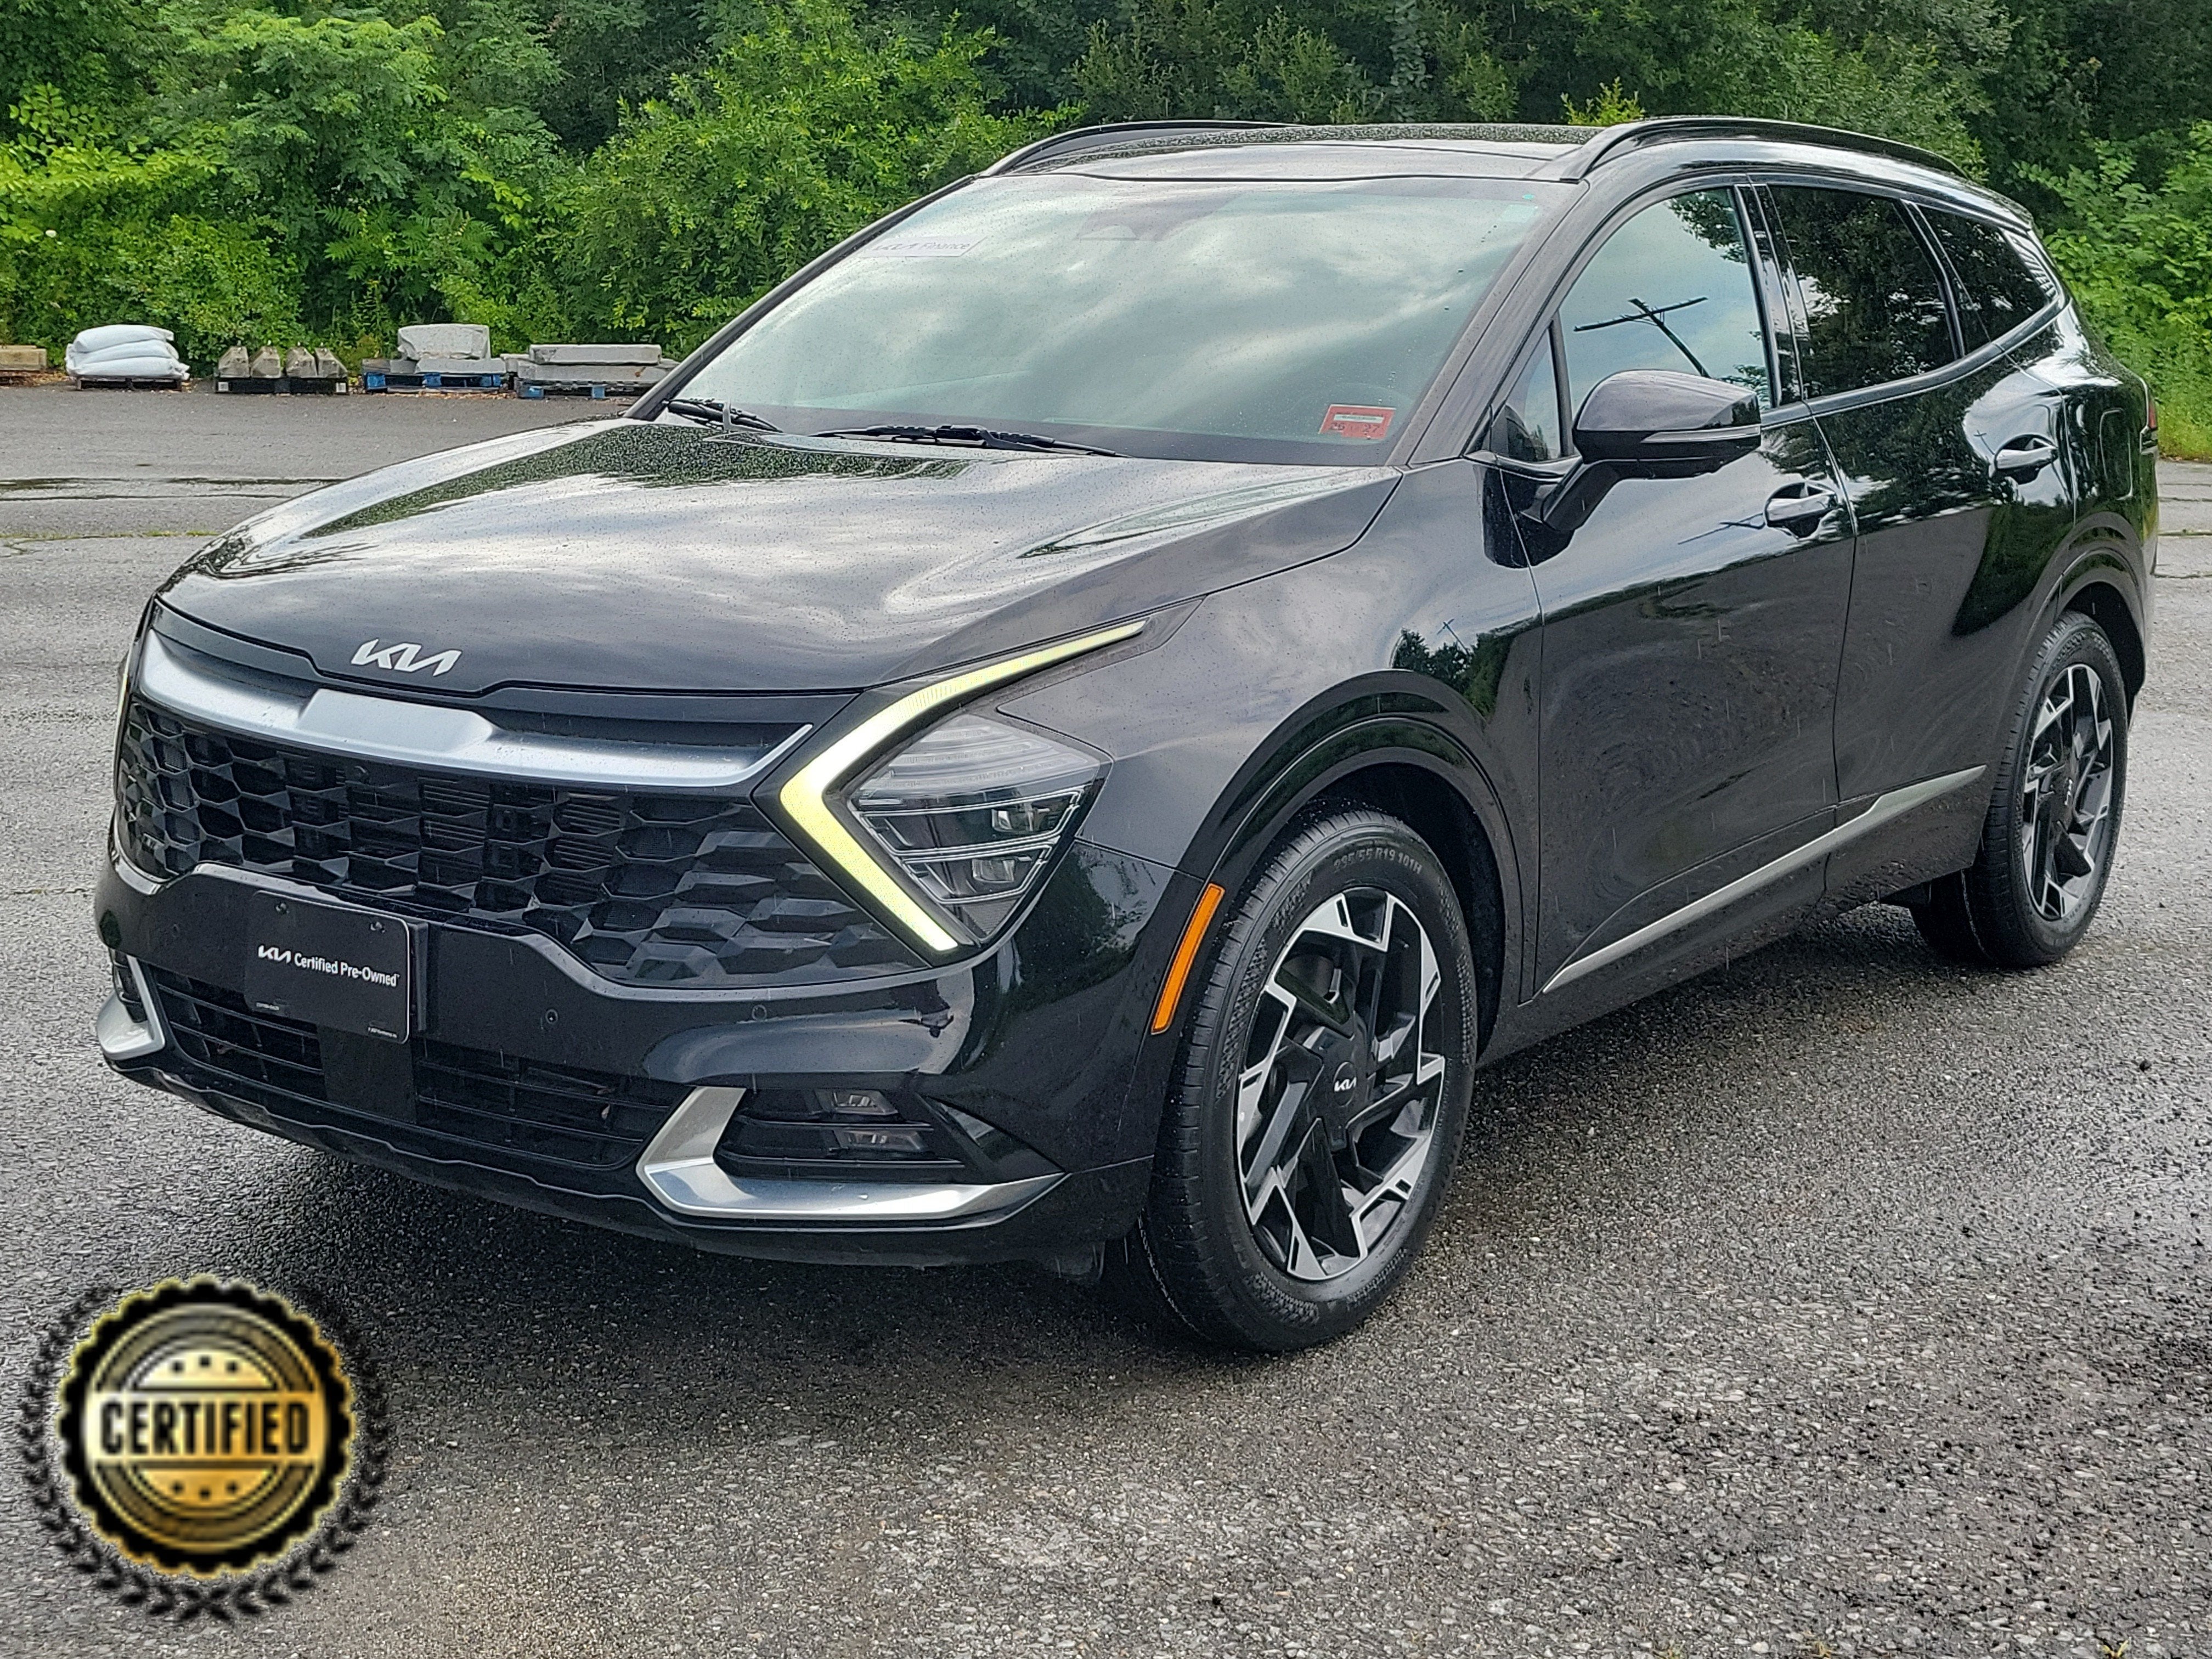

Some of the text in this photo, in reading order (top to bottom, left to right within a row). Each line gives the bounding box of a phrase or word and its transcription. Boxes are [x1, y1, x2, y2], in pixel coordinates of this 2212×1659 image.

[351, 638, 462, 677] KIA
[1375, 847, 1396, 861] R19
[1398, 852, 1423, 874] 101H
[258, 945, 291, 963] KIA
[295, 952, 338, 974] Certified
[1334, 1076, 1357, 1092] KIA
